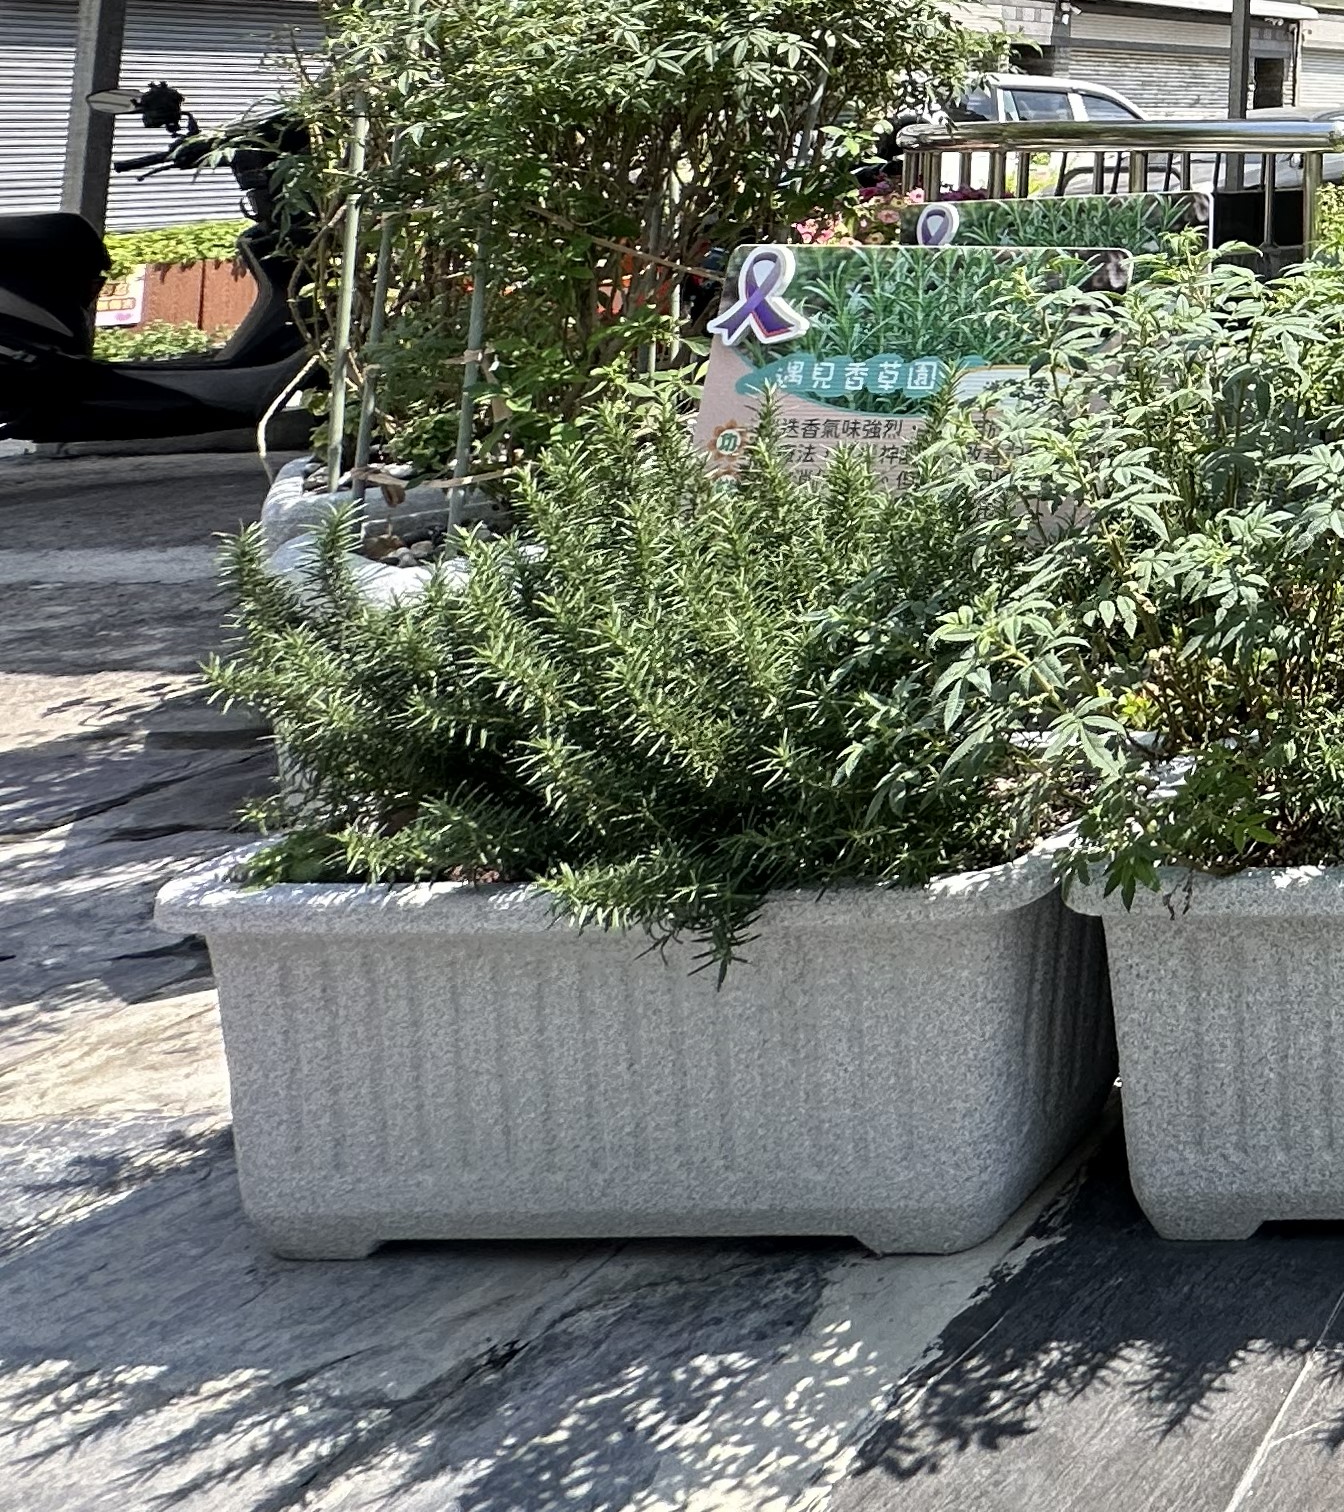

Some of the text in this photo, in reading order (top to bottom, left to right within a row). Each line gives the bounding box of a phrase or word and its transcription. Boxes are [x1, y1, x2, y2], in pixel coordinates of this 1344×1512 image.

[775, 360, 937, 390] 遇見香草園
